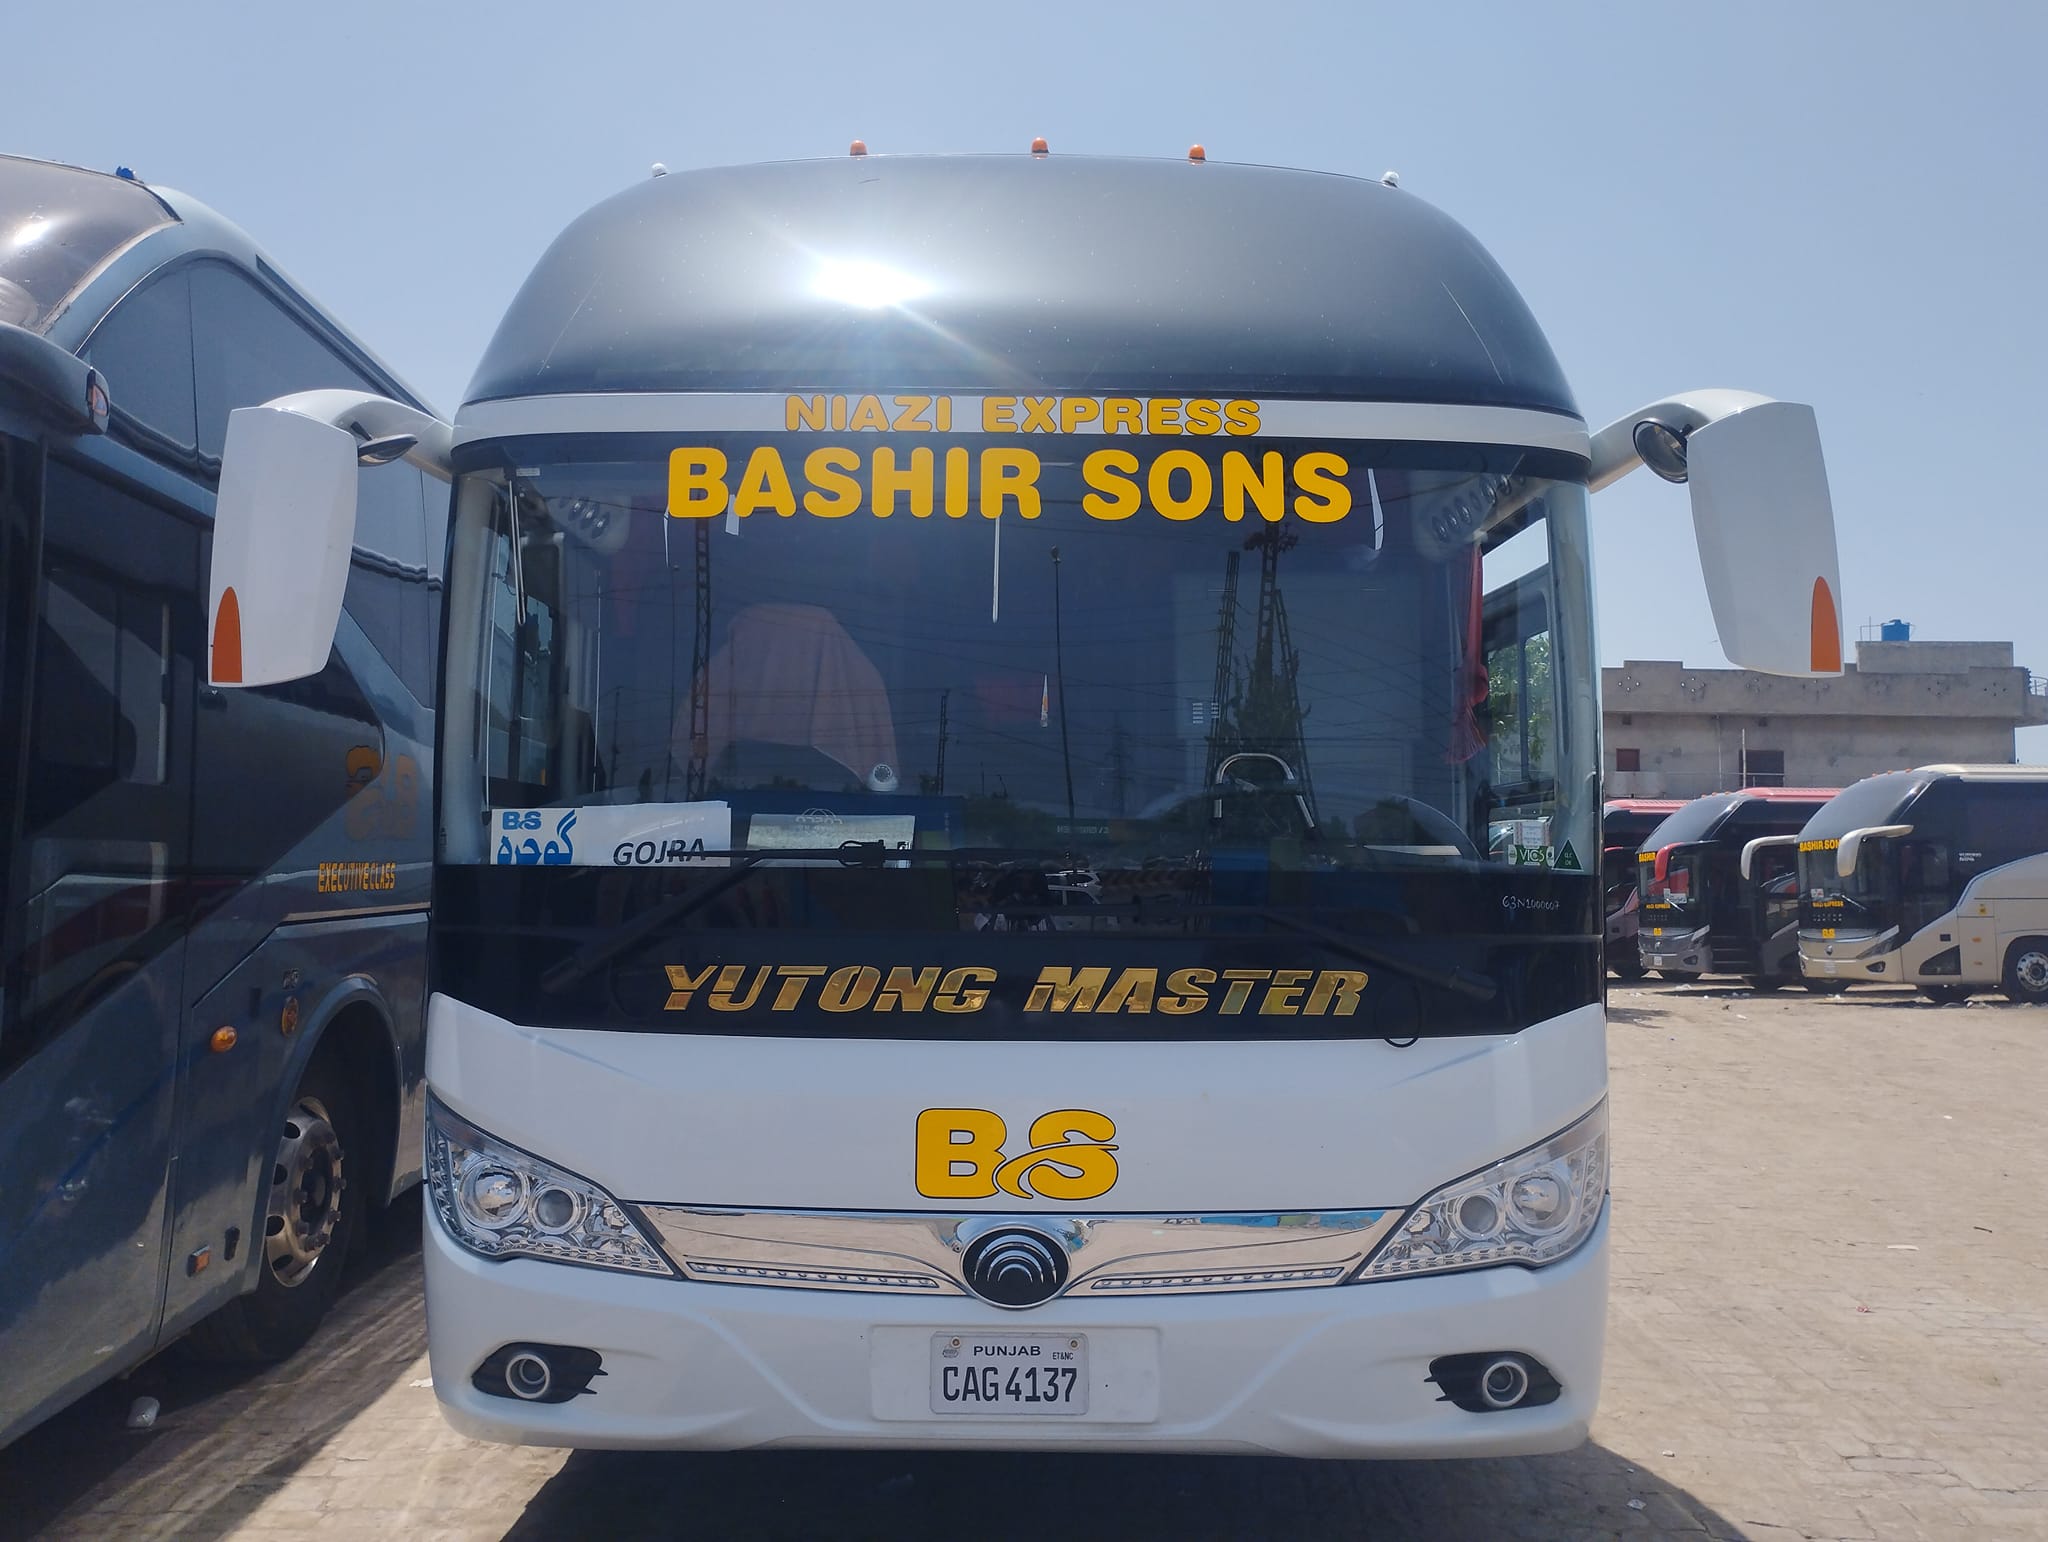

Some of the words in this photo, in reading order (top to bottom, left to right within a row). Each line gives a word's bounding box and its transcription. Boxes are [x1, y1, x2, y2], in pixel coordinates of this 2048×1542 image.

[784, 394, 953, 432] NIAZI
[981, 396, 1262, 436] EXPRESS
[668, 447, 1041, 519] BASHIR
[1082, 449, 1352, 523] SONS
[613, 838, 707, 866] GOJRA
[318, 862, 369, 893] EXECUTIVE
[369, 861, 397, 890] CLASS
[663, 964, 998, 1013] YUTONG
[1022, 965, 1369, 1016] MASTER
[973, 1345, 1041, 1357] PUNJAB
[943, 1366, 999, 1402] CAG
[1004, 1366, 1078, 1403] 4137
